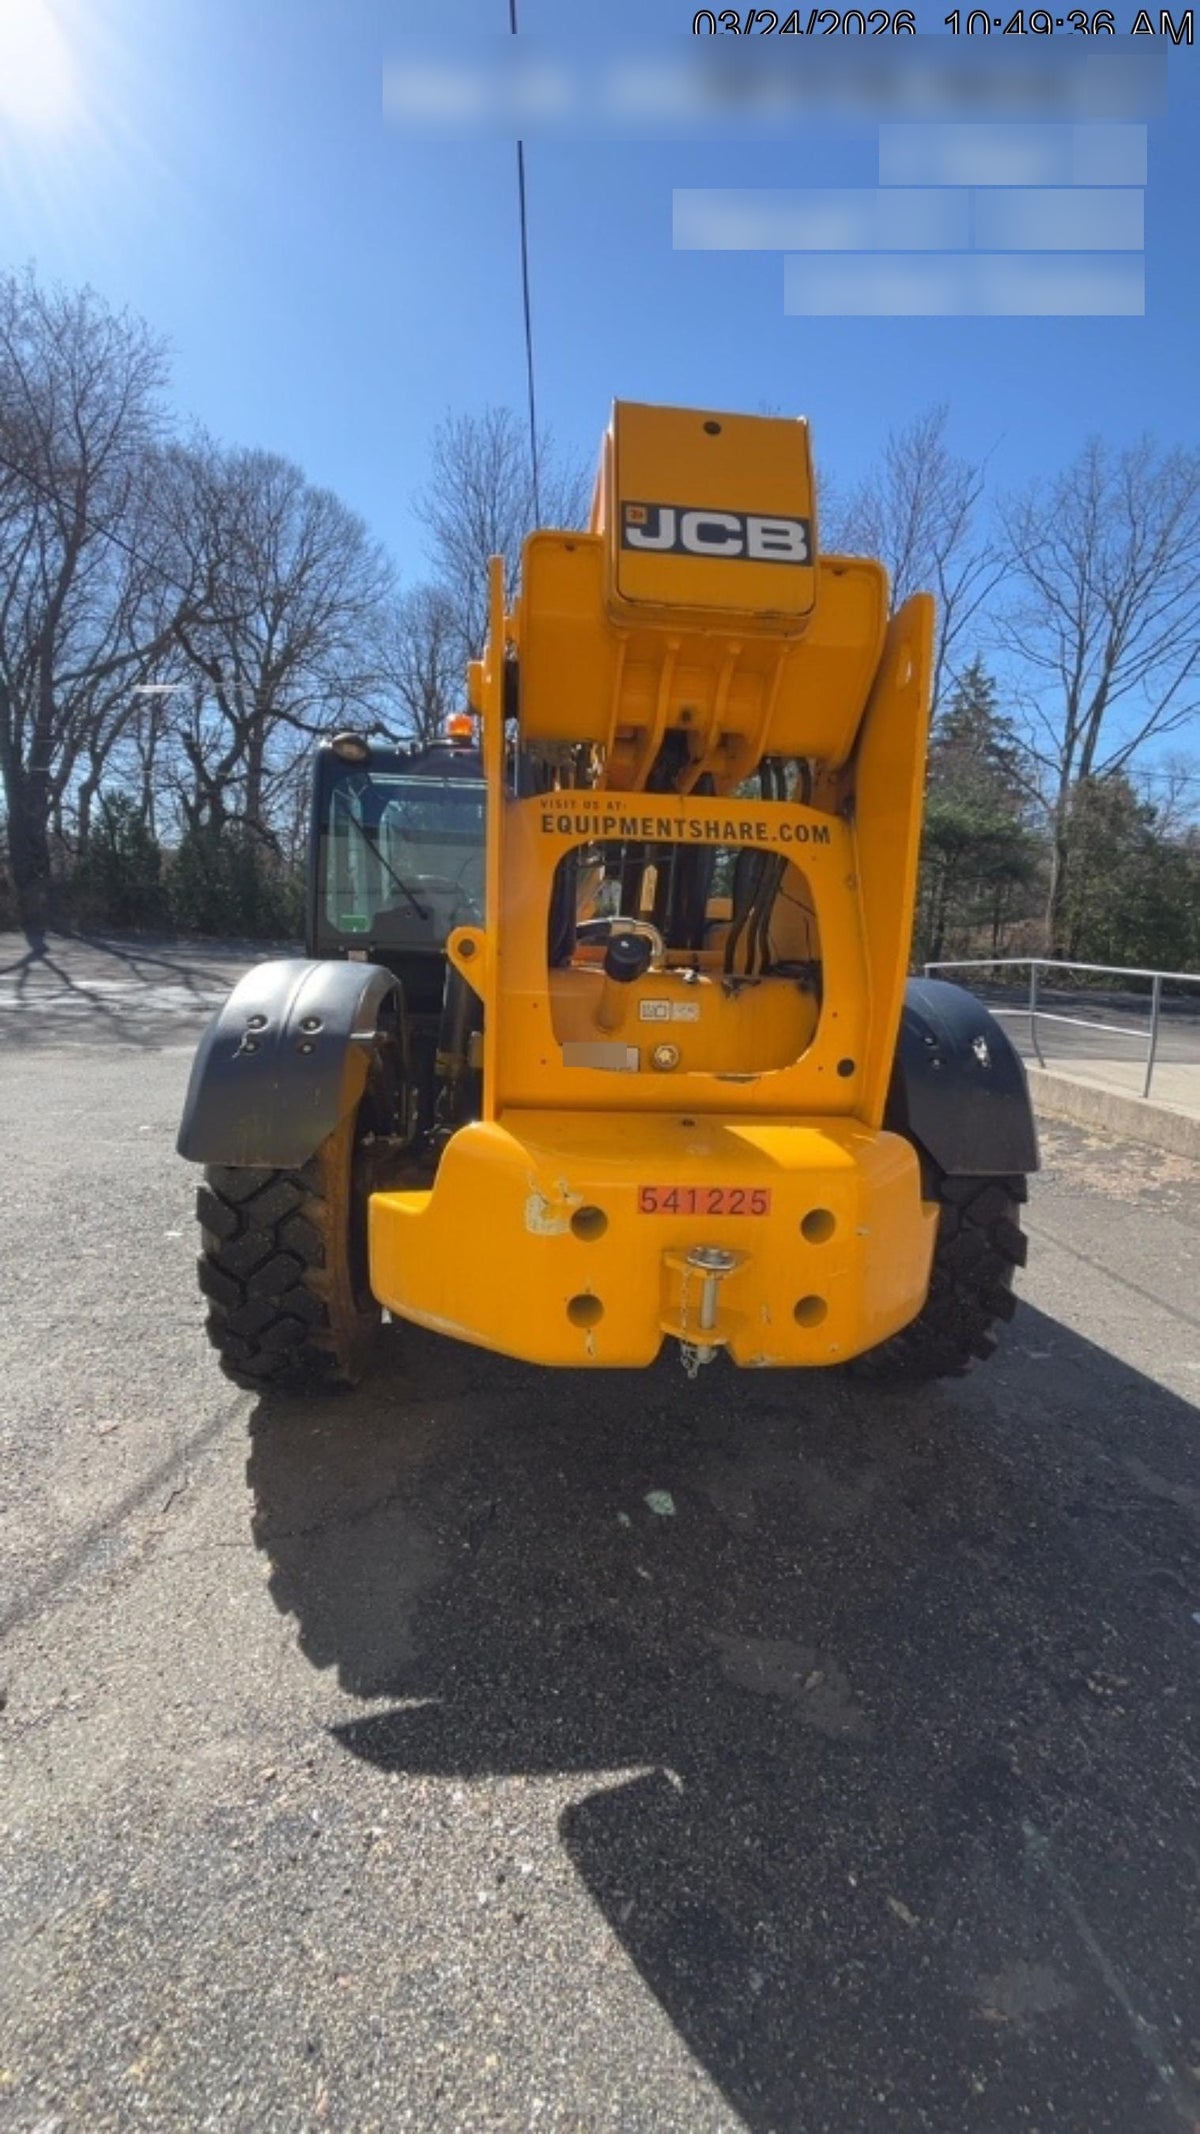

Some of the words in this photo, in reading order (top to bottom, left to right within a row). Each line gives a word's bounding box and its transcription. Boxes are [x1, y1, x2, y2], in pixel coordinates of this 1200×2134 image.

[625, 508, 808, 561] JCB
[541, 800, 576, 810] VISIT
[583, 801, 599, 810] US
[541, 815, 831, 844] EQUIPMENTSHARE.COM
[640, 1187, 768, 1216] 541225
